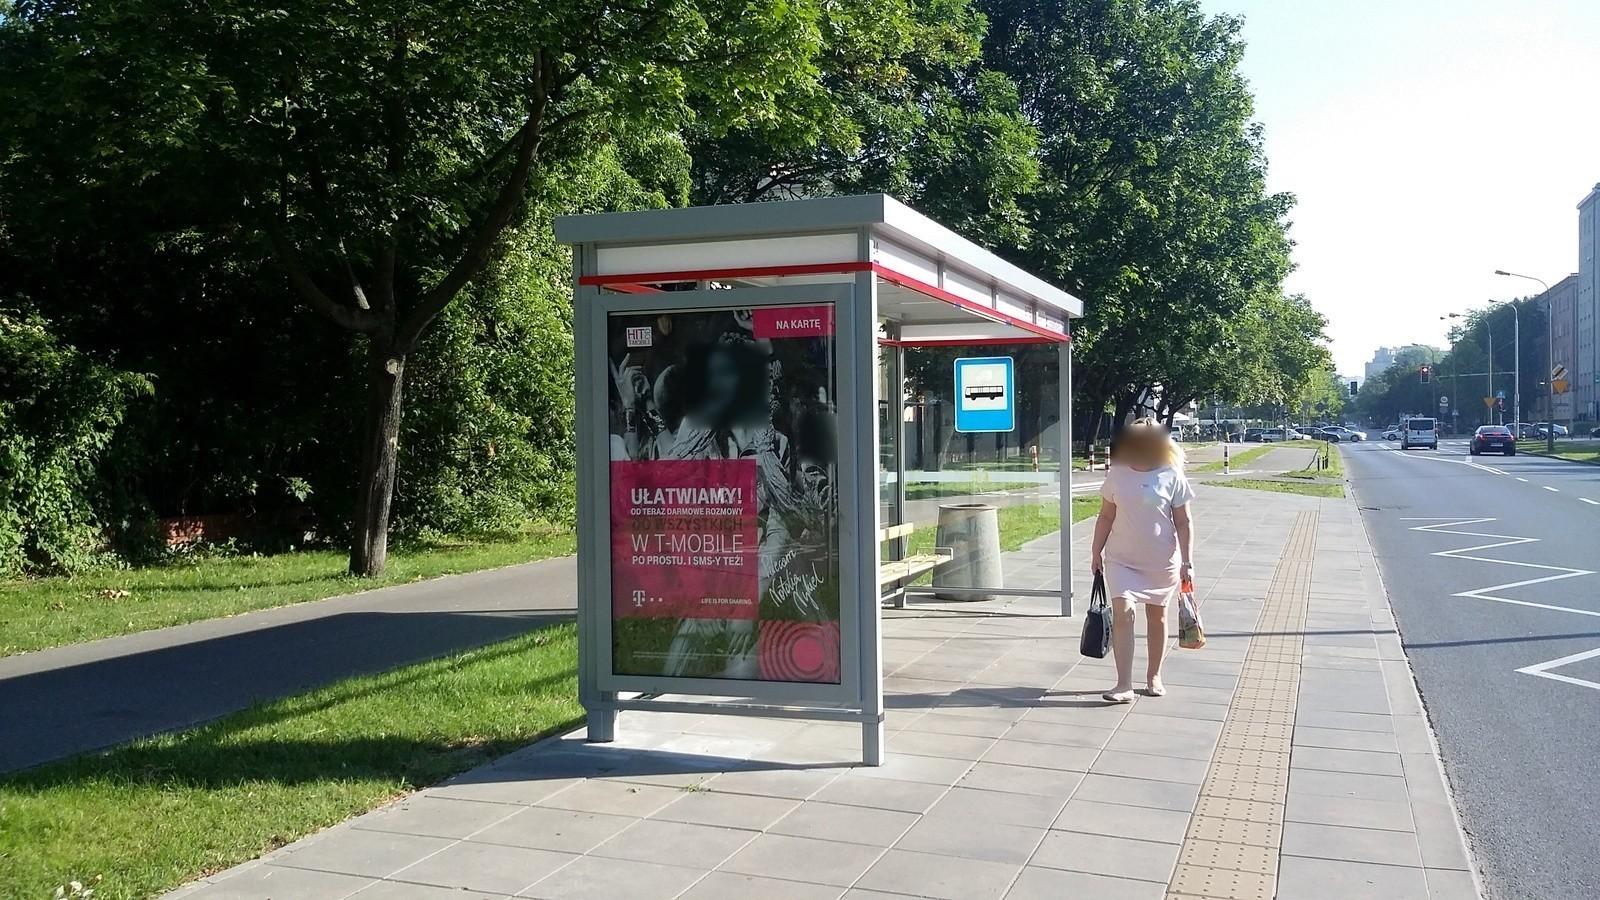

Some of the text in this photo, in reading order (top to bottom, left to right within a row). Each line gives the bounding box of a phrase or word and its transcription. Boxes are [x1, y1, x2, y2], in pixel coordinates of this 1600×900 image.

[776, 319, 821, 330] NA KARTĘ
[628, 329, 645, 340] HIT
[631, 487, 742, 505] UŁATWIAMY!
[655, 518, 742, 531] WSZYSTKICH
[631, 534, 743, 553] W T-MOBILE
[632, 554, 743, 566] PO PROSTU. I SMS-Y TEŻ!
